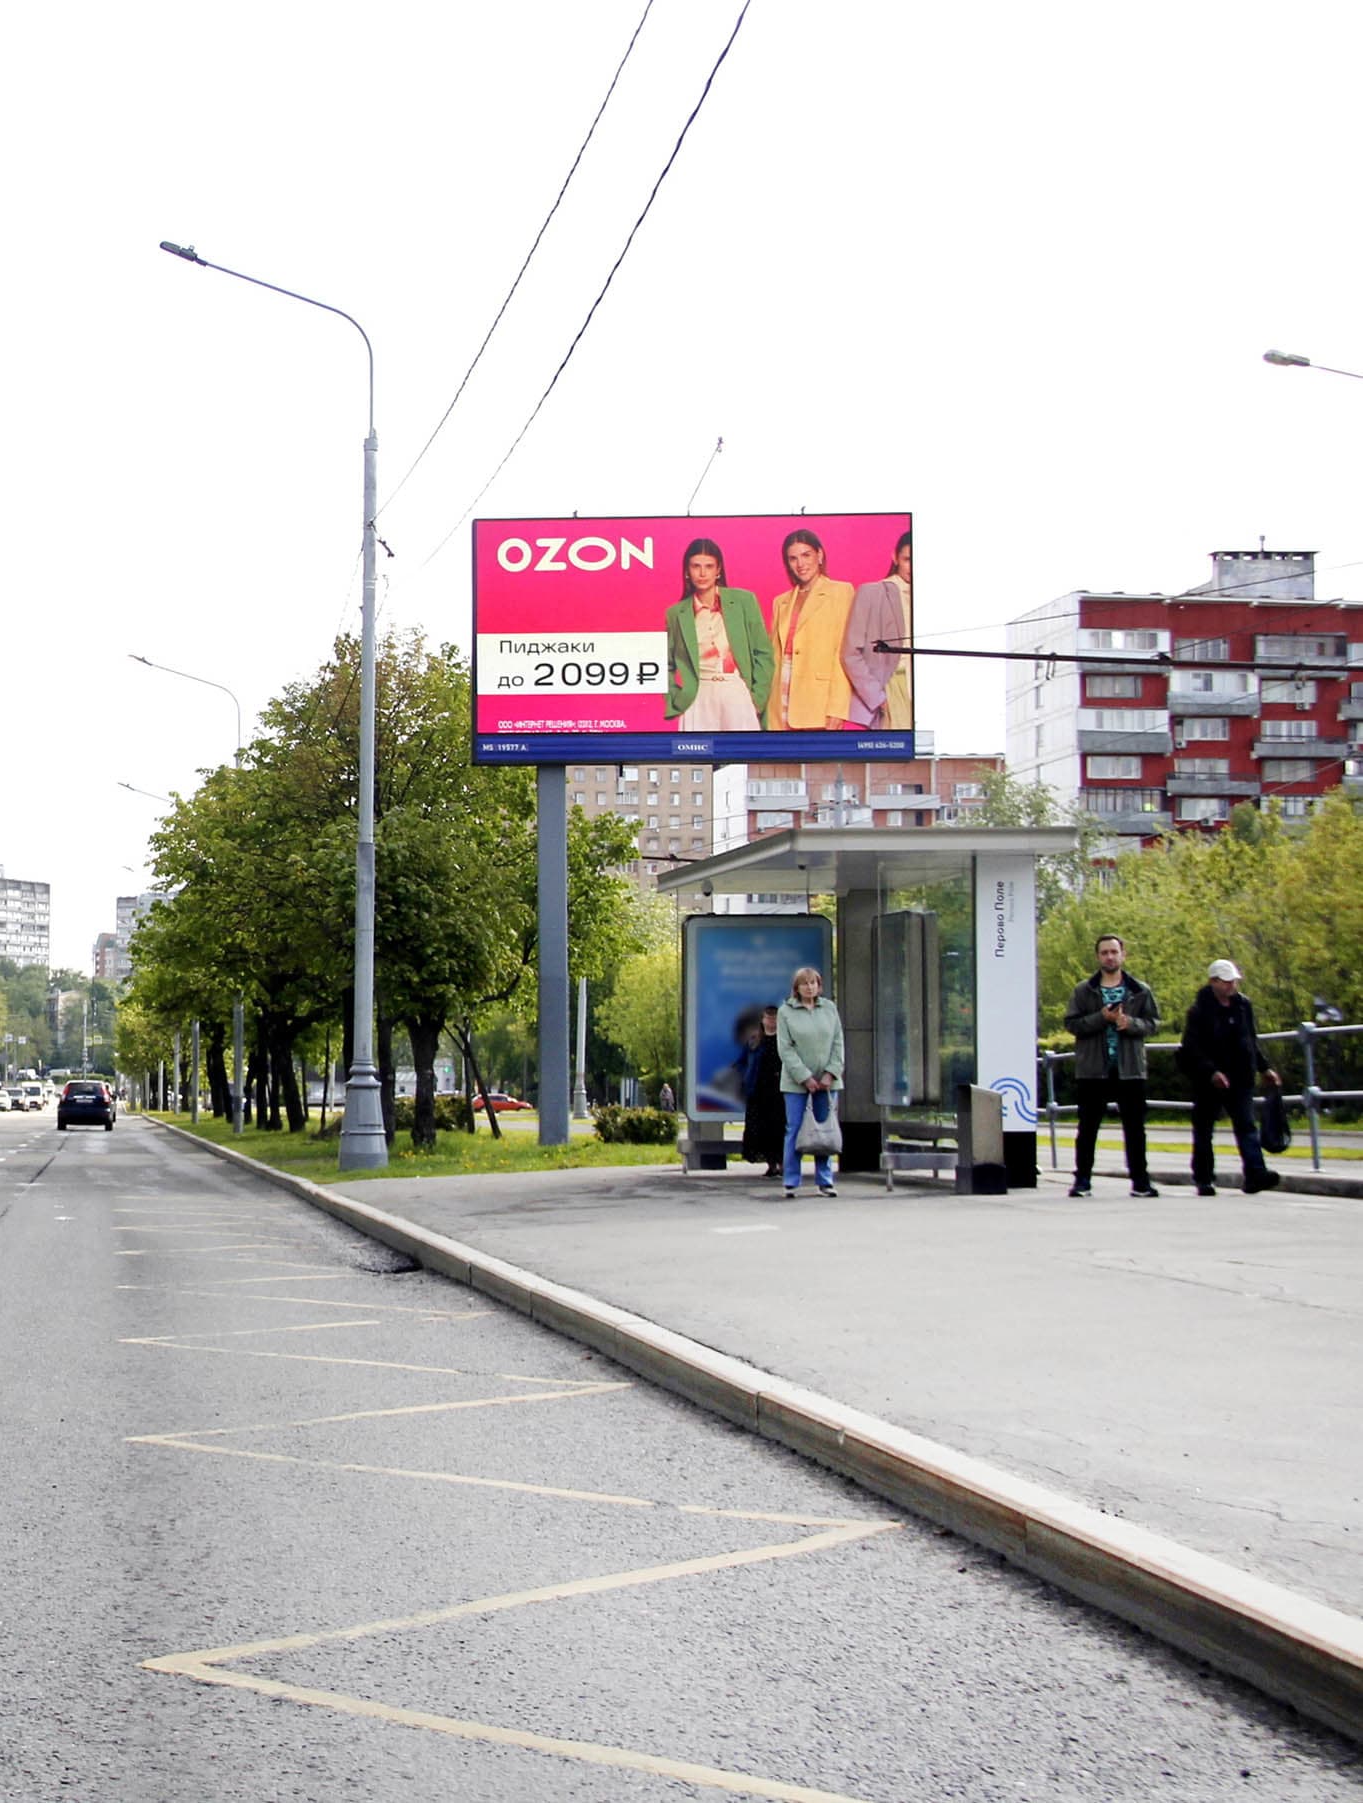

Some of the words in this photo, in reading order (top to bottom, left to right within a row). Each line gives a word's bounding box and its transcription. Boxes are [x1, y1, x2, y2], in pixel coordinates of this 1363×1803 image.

[497, 537, 654, 572] OZON
[499, 640, 595, 655] Пиджаки
[497, 675, 524, 689] до
[995, 881, 1005, 910] Поле
[995, 914, 1006, 957] Перово
